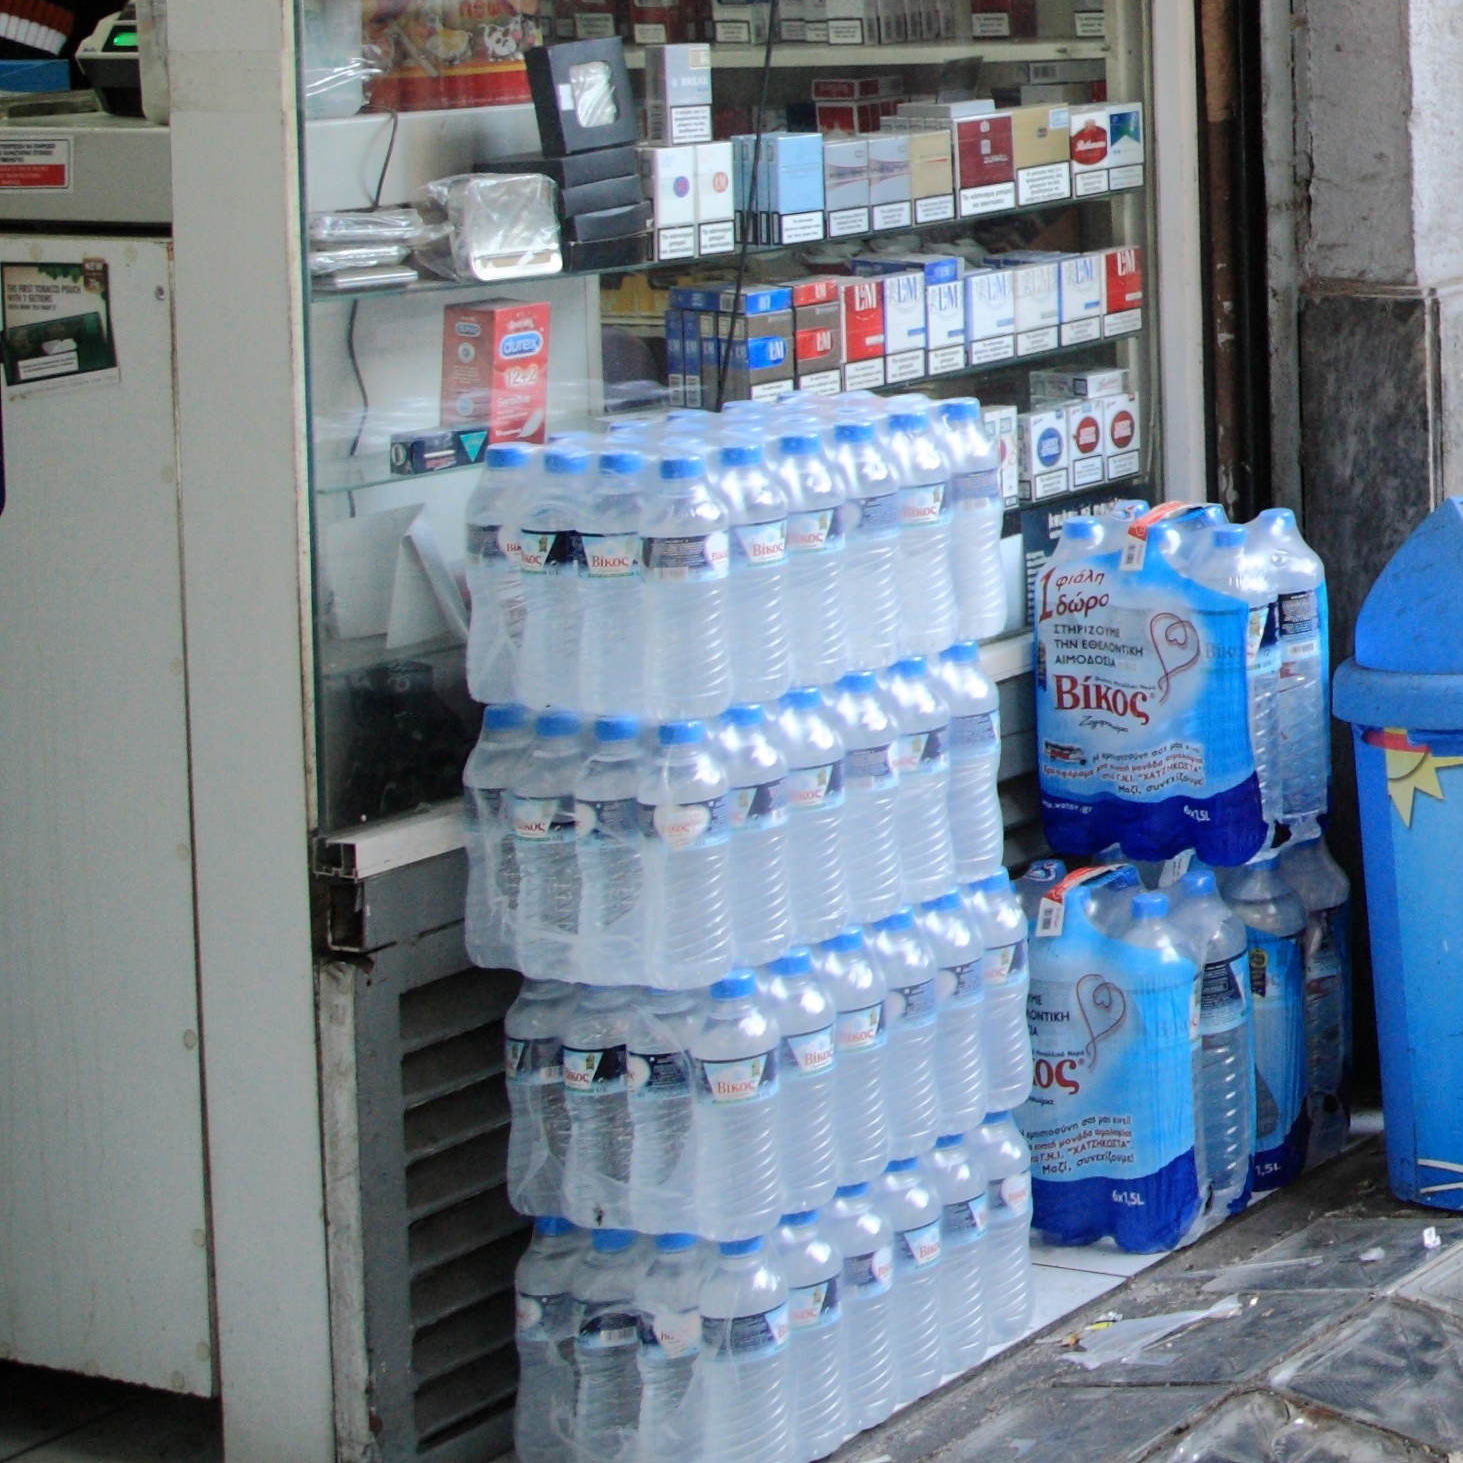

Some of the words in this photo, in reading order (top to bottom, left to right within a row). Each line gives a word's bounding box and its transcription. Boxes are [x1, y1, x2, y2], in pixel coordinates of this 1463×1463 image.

[853, 282, 878, 312] L&M
[503, 336, 539, 354] durex
[591, 555, 629, 568] Βίκος
[1055, 568, 1105, 590] φιάλη
[1056, 591, 1110, 618] δώρο
[1053, 623, 1121, 638] ΣΤΗΡΙΖΟΥΜΕ
[1054, 639, 1078, 649] ΤΗΝ
[1082, 638, 1144, 657] ΕΘΕΛΟΝΤΙΚΗ
[1055, 654, 1117, 668] ΑΙΜΟΔΟΣΙΑ
[1054, 674, 1150, 726] Βίκος
[716, 1079, 757, 1095] Βίκος
[1042, 1161, 1072, 1175] Μαζί,
